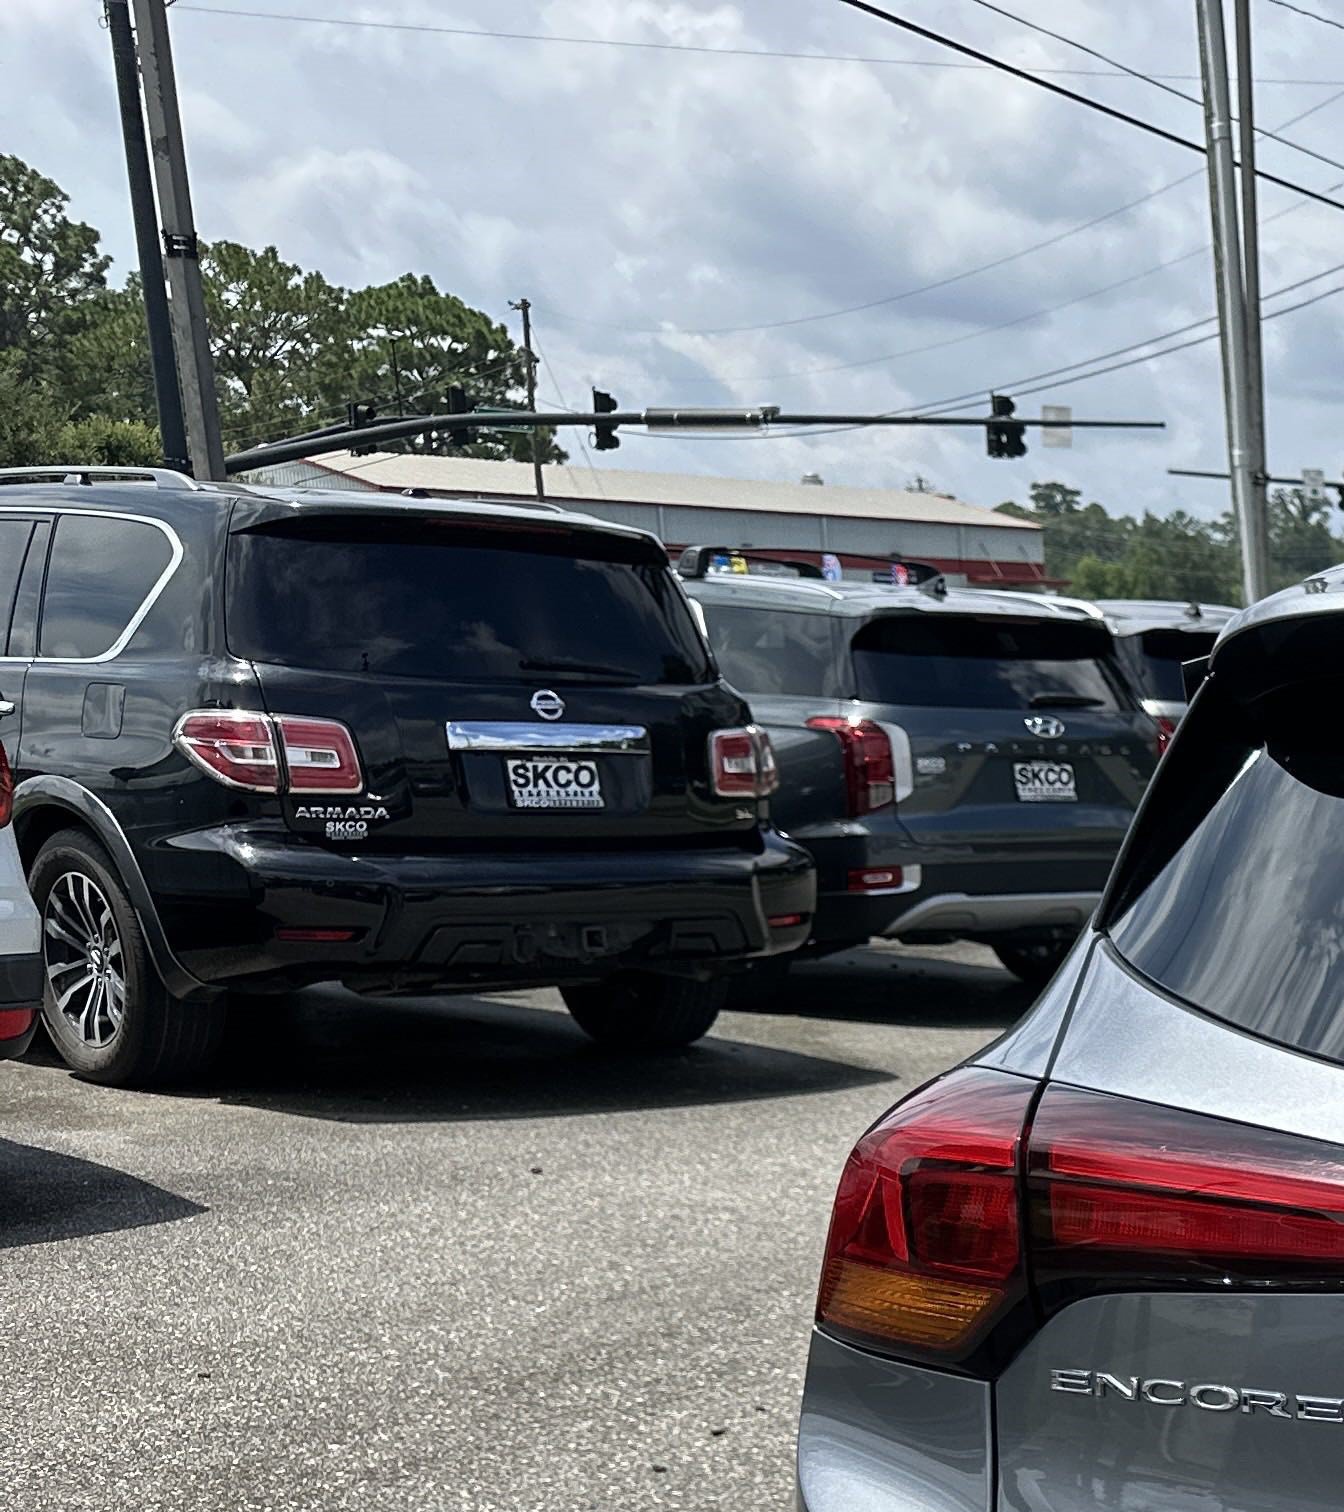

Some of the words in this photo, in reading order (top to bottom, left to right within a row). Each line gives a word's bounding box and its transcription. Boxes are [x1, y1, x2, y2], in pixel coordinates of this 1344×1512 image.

[512, 763, 596, 789] SKCO
[1018, 767, 1073, 786] SKCO
[294, 806, 391, 819] ARMADA
[325, 821, 368, 832] SKCO
